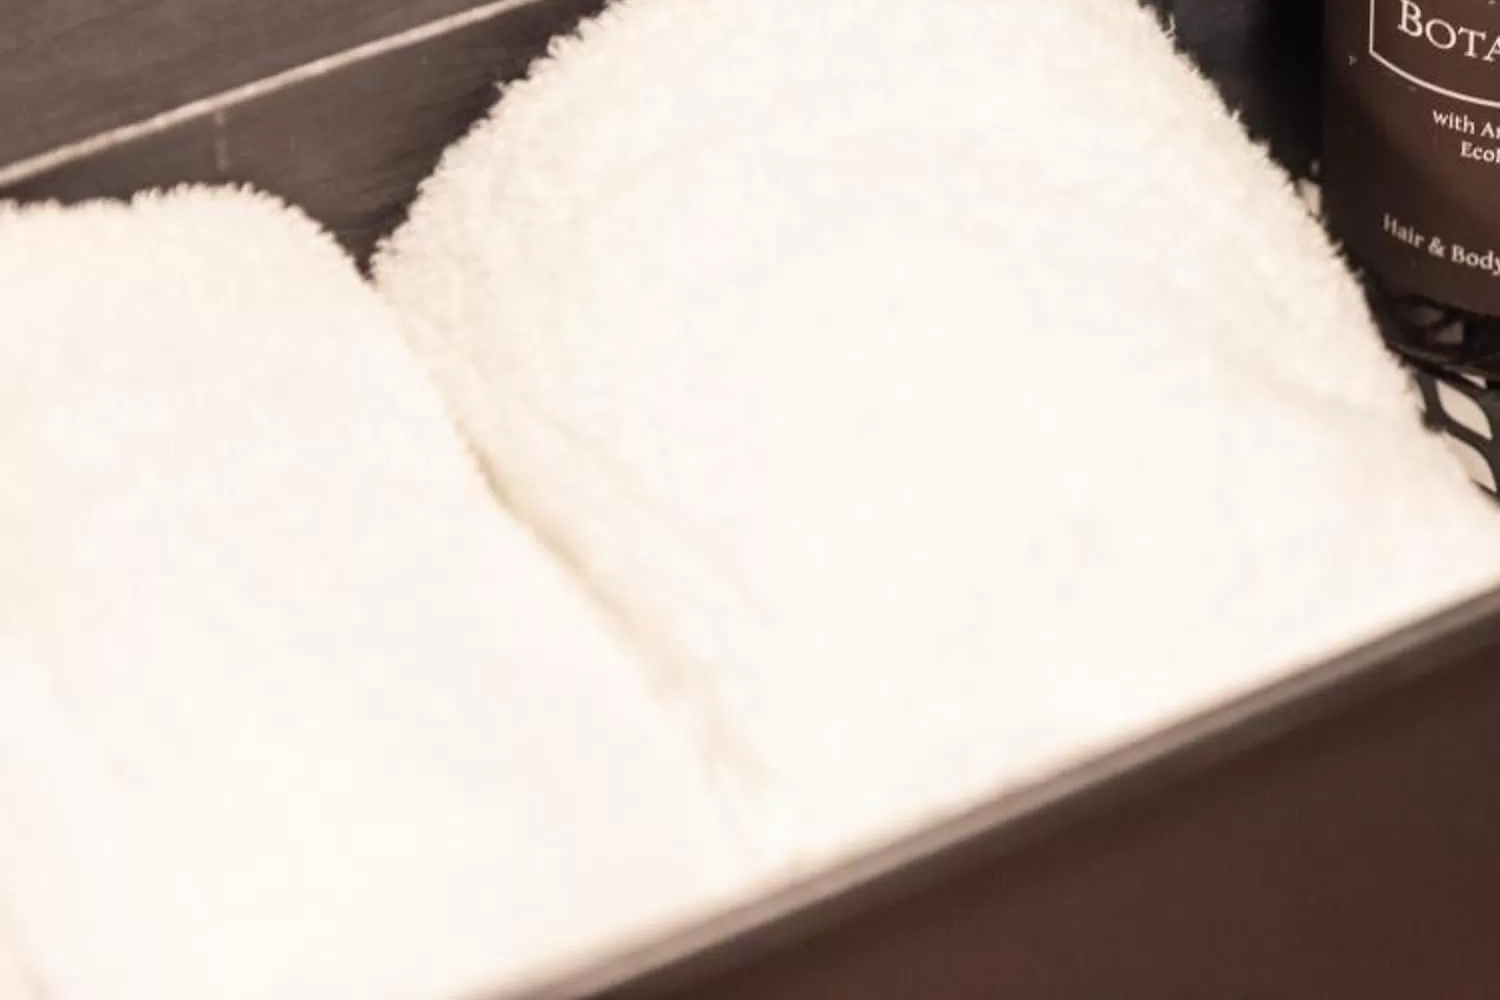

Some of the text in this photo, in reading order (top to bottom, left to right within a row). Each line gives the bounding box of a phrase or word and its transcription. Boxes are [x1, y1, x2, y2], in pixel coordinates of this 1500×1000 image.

[1432, 109, 1475, 136] with
[1383, 213, 1424, 248] Hair
[1428, 238, 1446, 258] &
